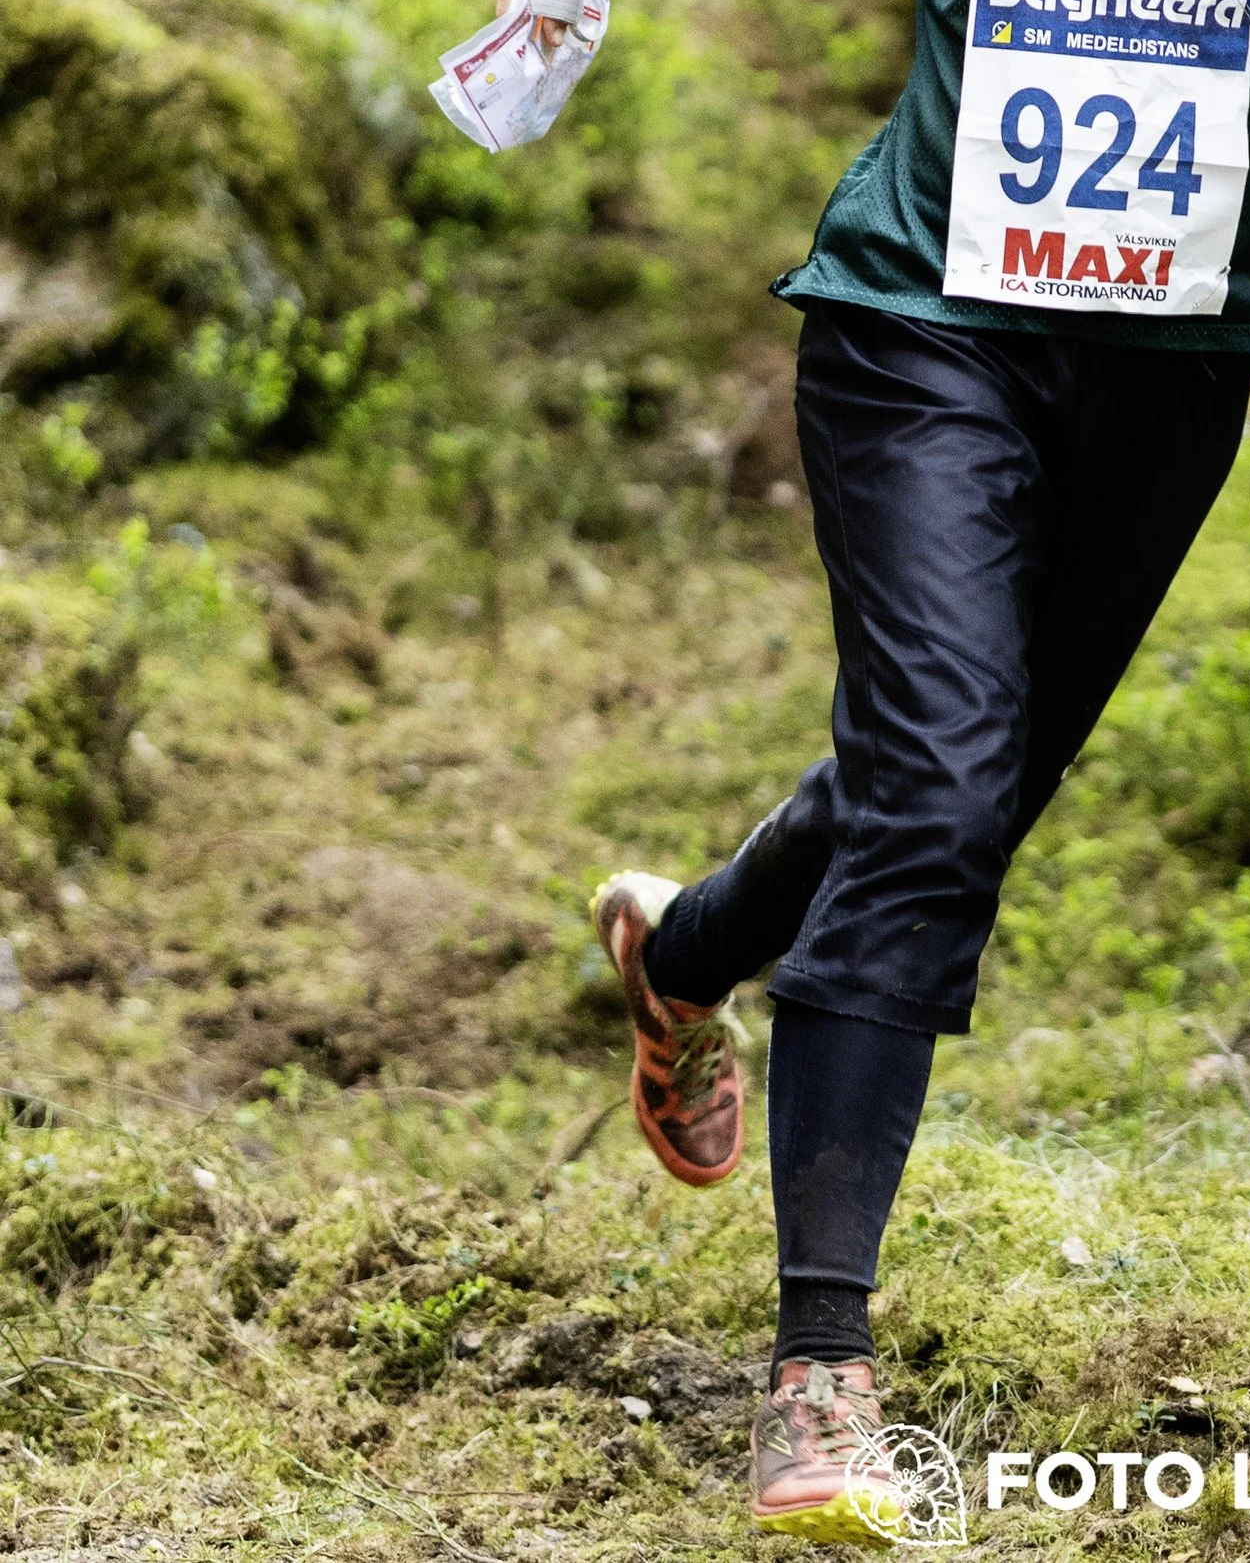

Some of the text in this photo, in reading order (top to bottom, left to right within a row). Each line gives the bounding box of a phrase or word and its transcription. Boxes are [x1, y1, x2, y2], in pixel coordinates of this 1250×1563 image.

[1023, 27, 1200, 59] SM MEDELDISTANS
[999, 87, 1202, 217] 924
[1002, 227, 1175, 286] MAXI
[1115, 234, 1177, 247] VÄLSVIKEN
[1000, 278, 1167, 302] ICA STORMARKNAD
